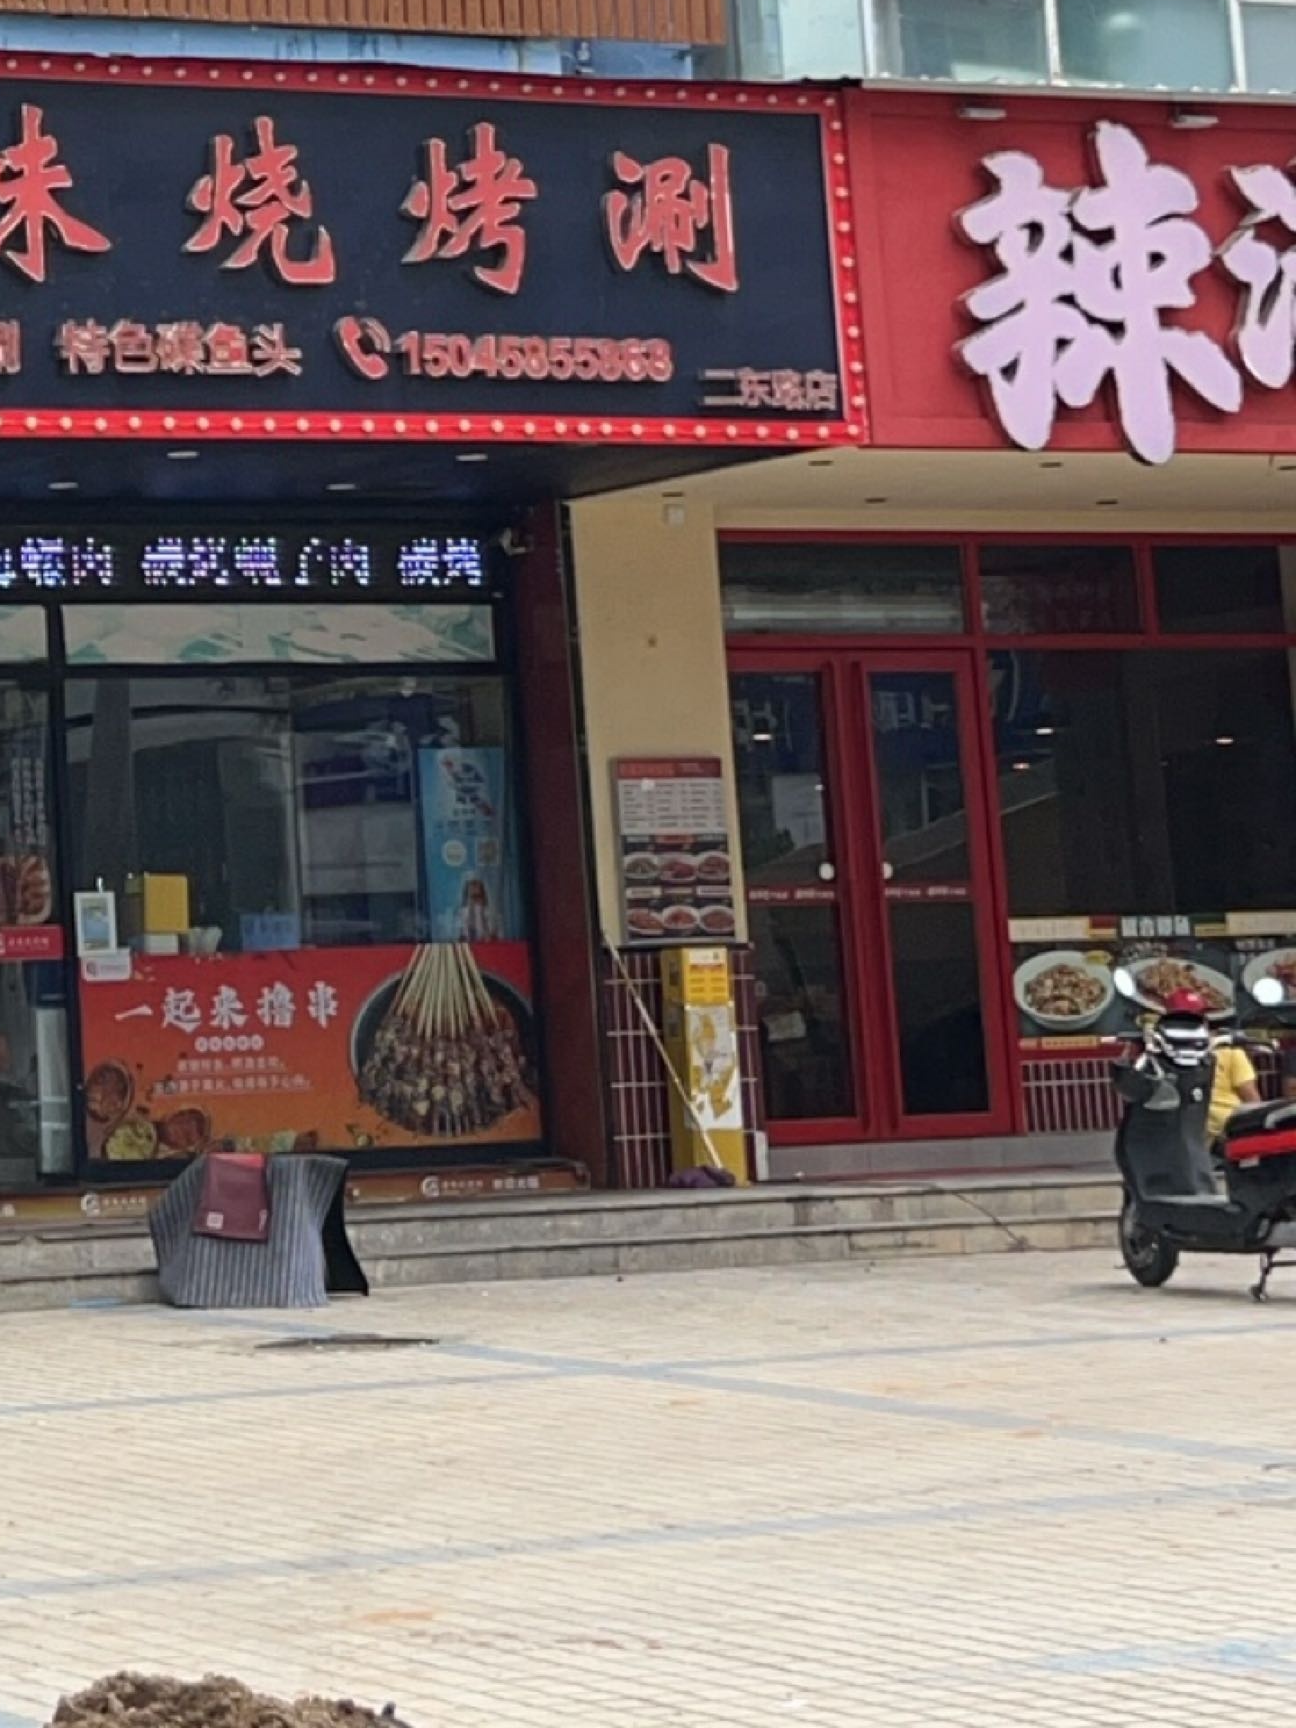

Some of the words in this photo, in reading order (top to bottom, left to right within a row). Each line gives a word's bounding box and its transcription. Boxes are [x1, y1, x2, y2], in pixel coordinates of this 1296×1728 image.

[114, 980, 340, 1032] 一起来撸串
